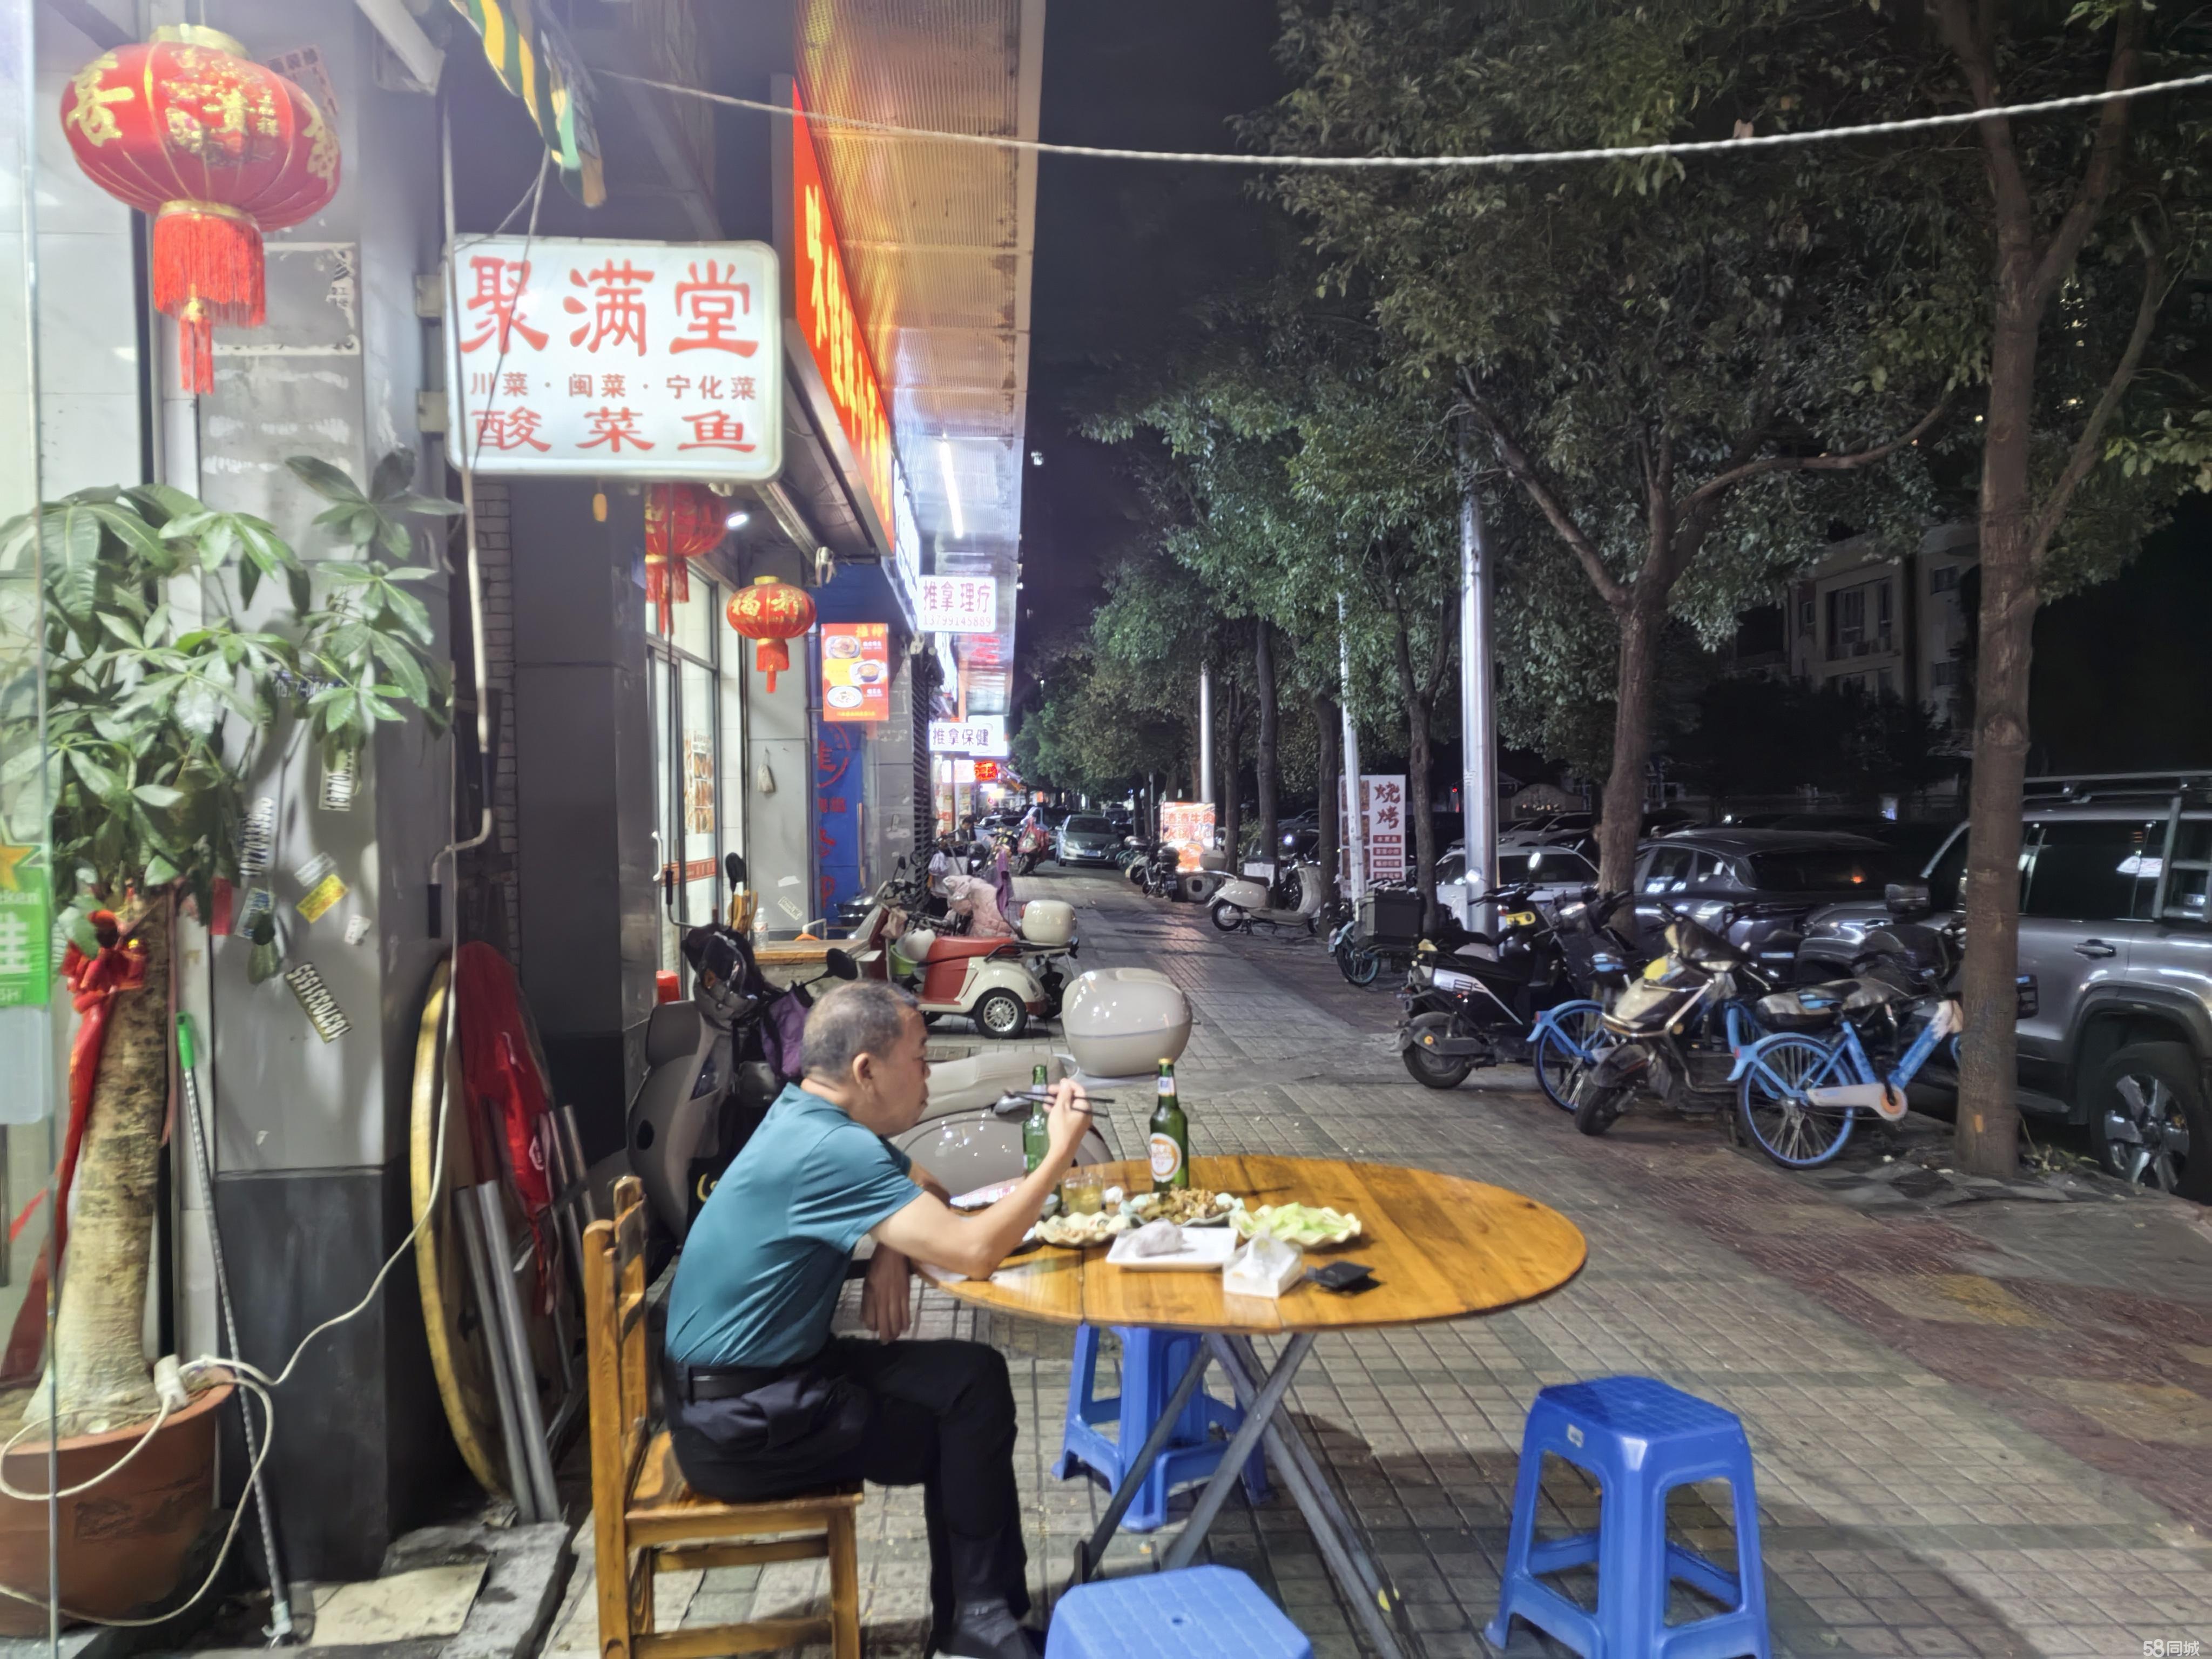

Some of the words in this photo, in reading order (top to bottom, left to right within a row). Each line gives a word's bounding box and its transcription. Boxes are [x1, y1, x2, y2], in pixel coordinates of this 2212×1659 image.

[460, 255, 759, 358] 聚满堂
[470, 406, 757, 453] 酸菜鱼
[923, 580, 991, 612] 推拿理疗
[933, 728, 988, 746] 推拿保健
[1374, 781, 1400, 830] 烧烤
